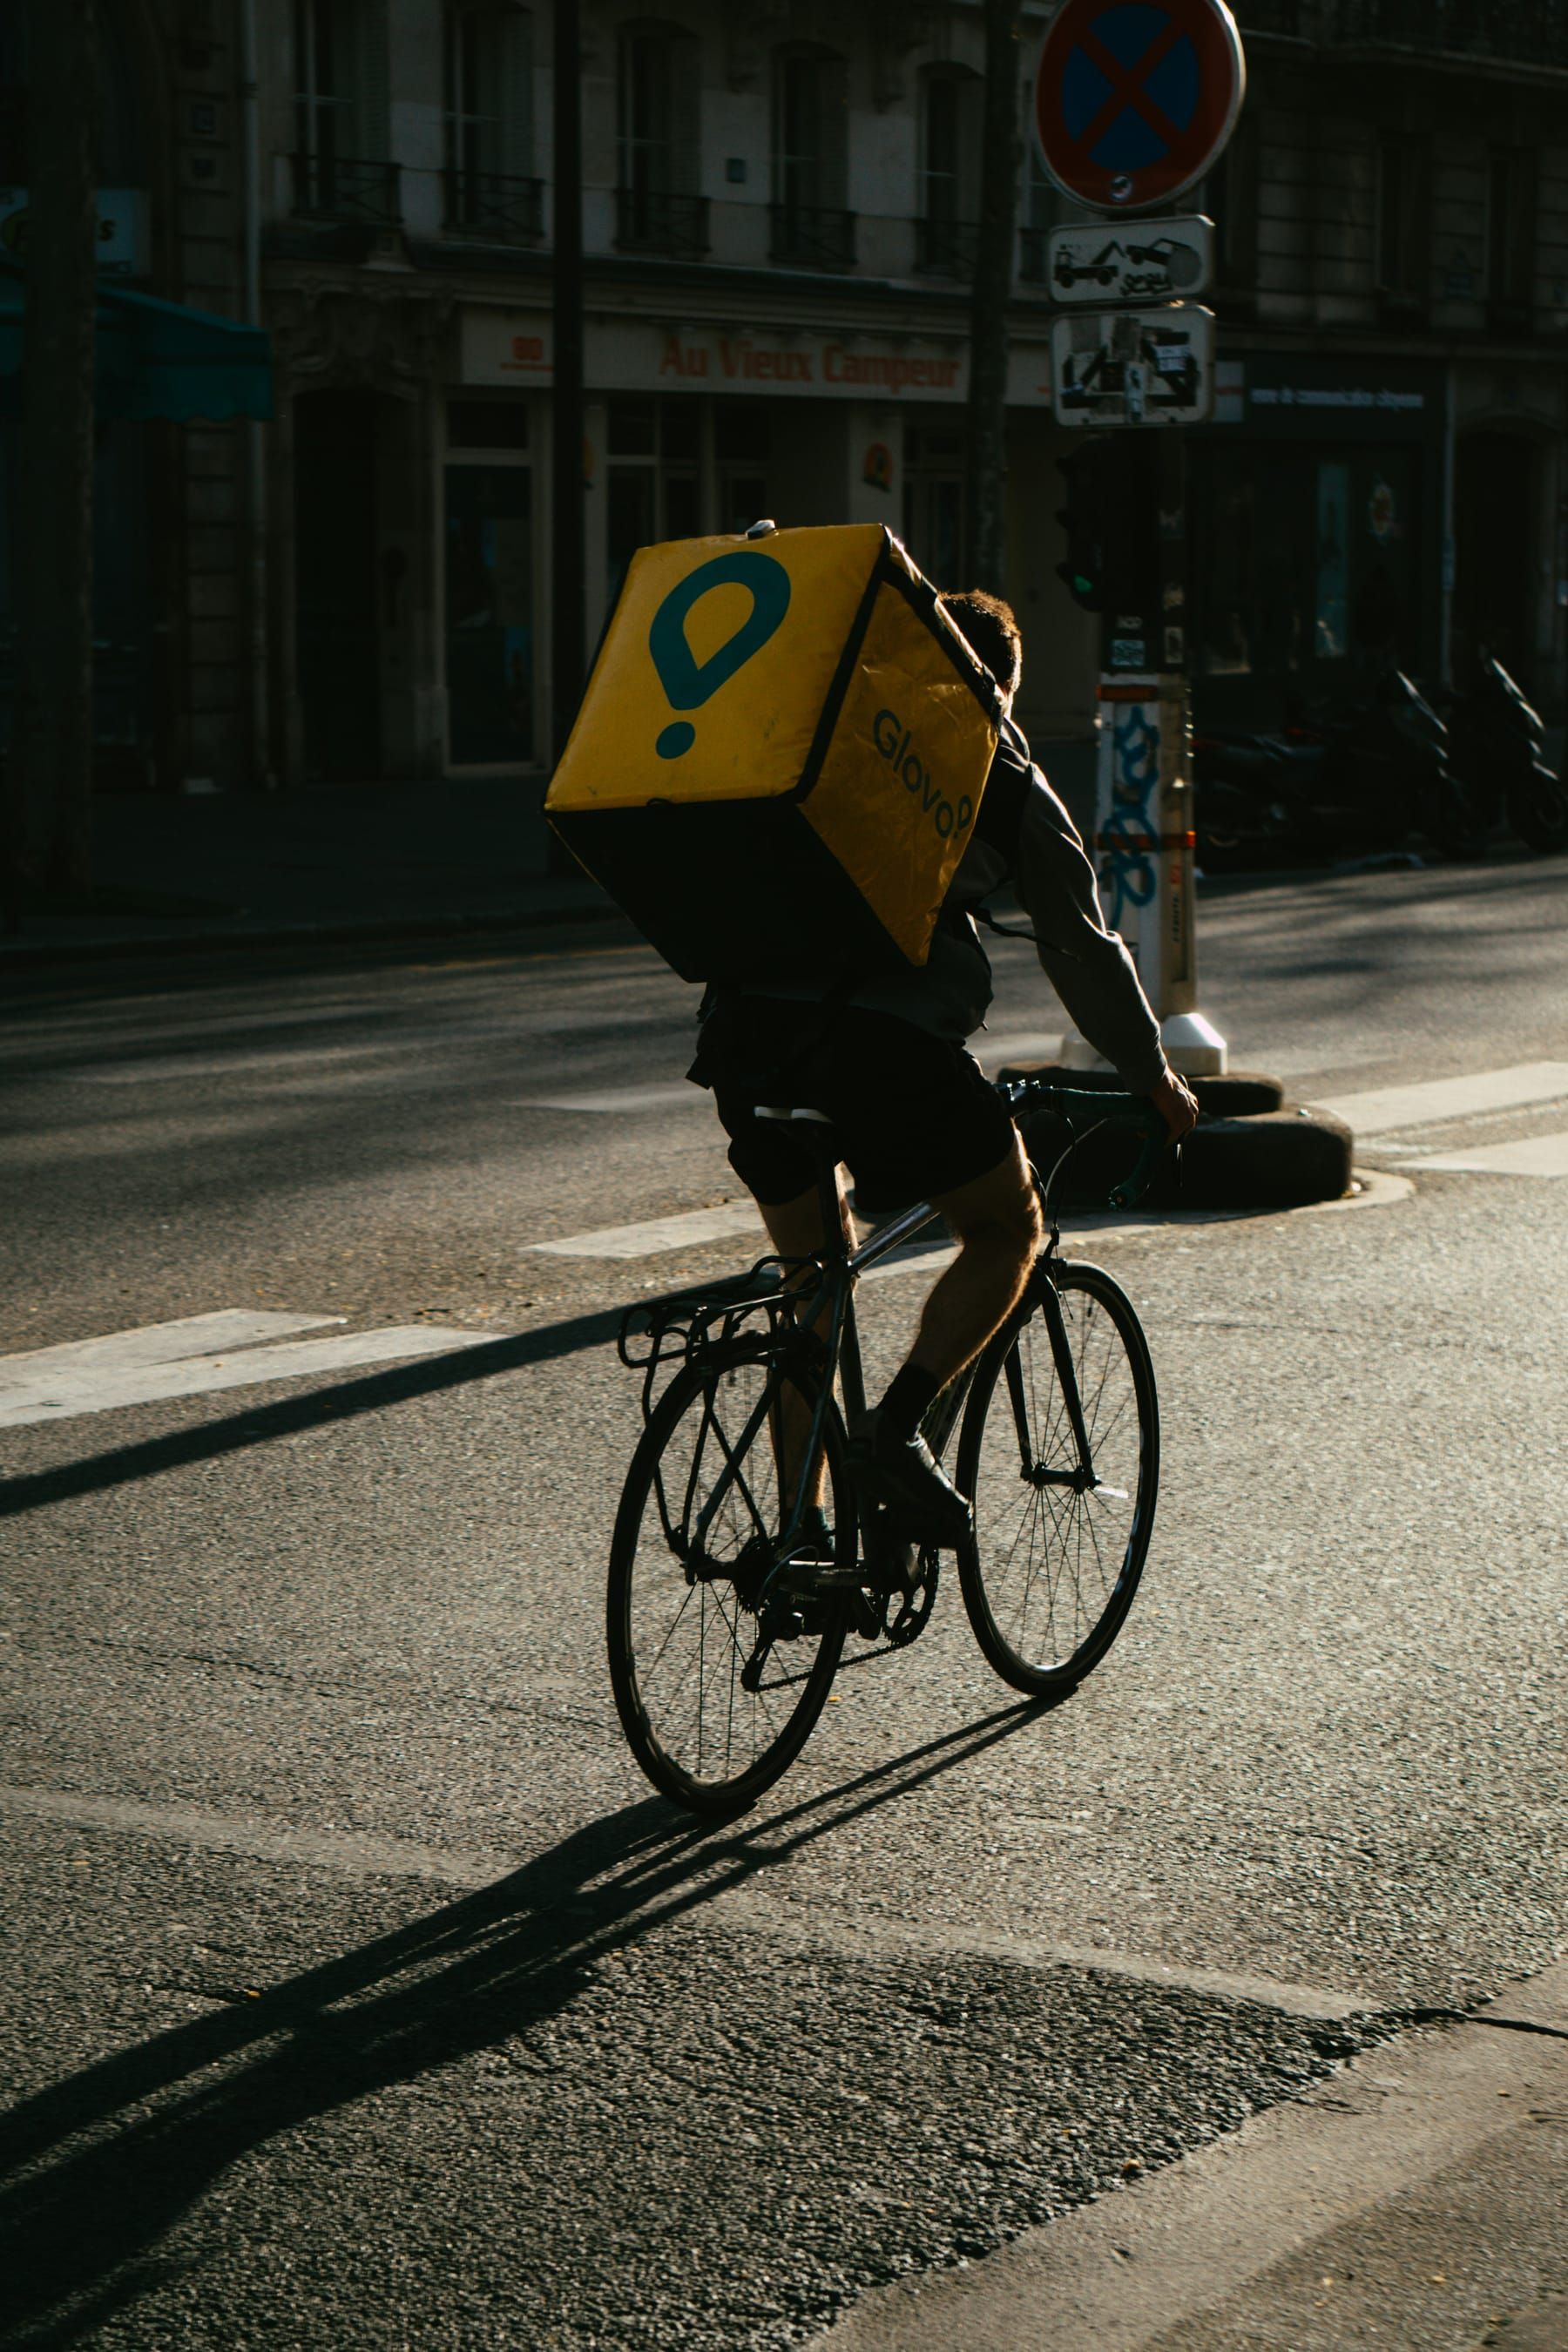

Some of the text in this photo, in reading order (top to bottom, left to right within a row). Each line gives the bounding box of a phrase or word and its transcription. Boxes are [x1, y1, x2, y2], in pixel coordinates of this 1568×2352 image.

[660, 335, 961, 395] Au Vieux Campeur
